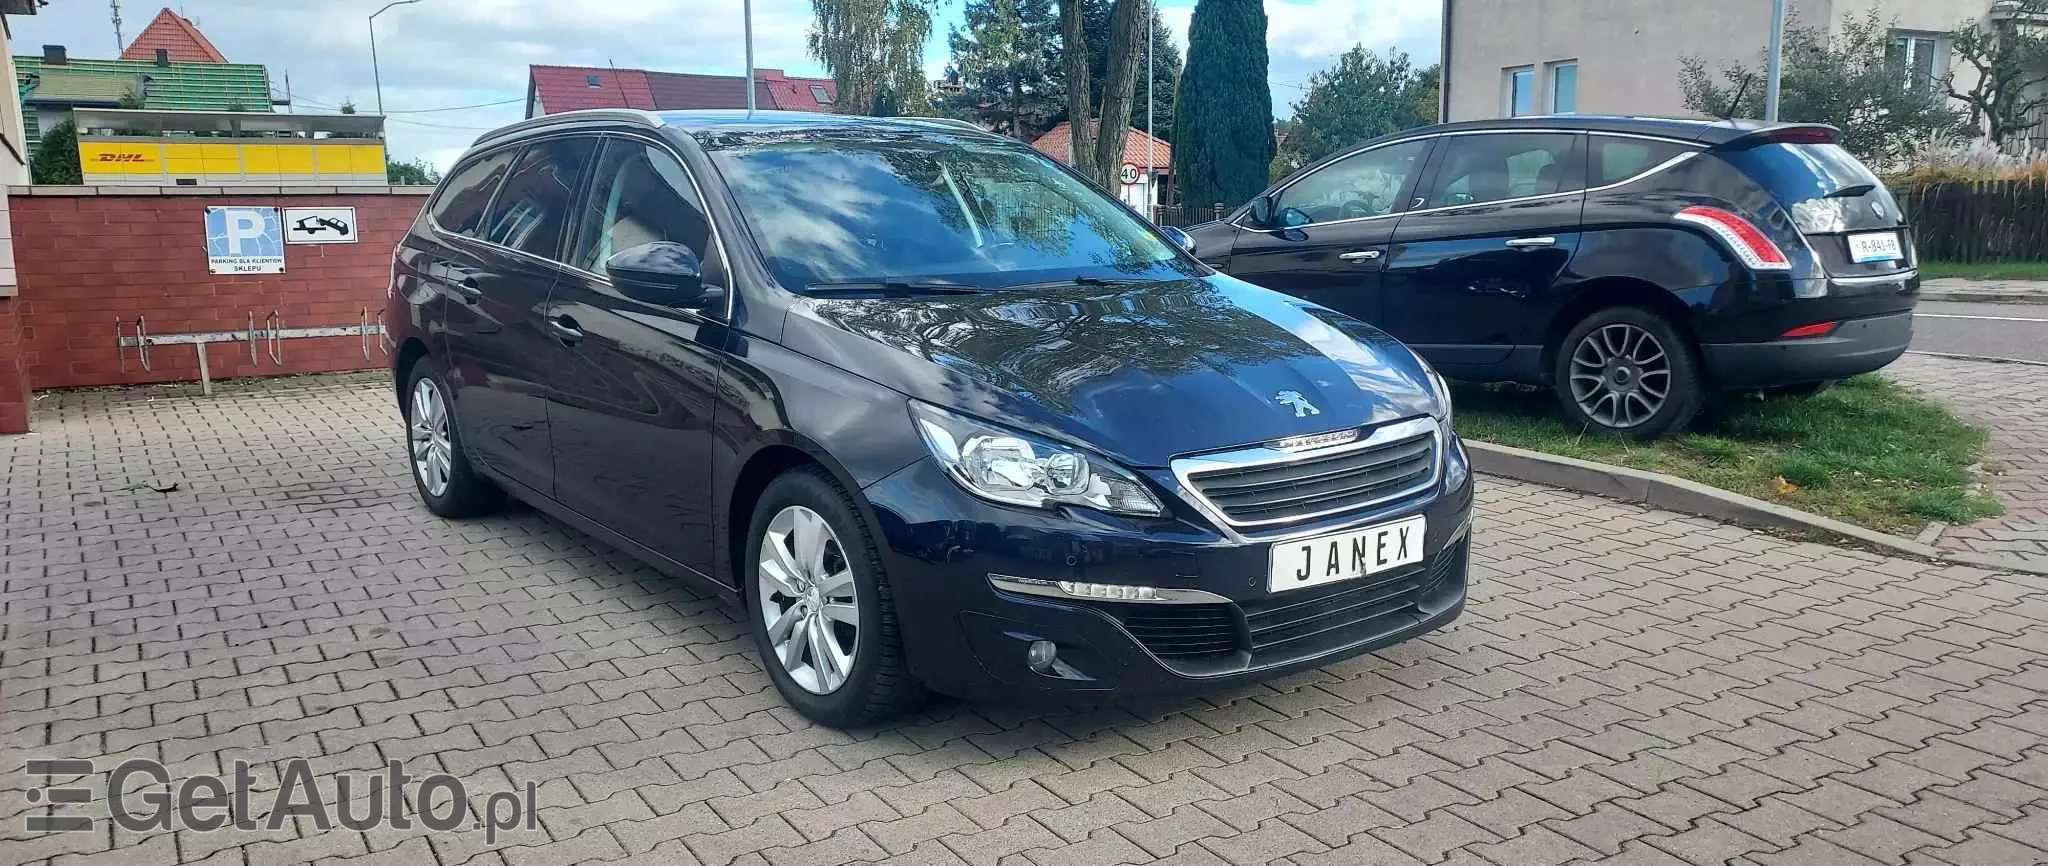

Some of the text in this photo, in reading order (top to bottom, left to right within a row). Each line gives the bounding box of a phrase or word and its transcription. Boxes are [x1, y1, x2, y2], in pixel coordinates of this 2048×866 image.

[98, 153, 145, 162] DHL
[1121, 168, 1137, 179] 40
[225, 209, 265, 255] P
[1296, 526, 1410, 581] JANEX
